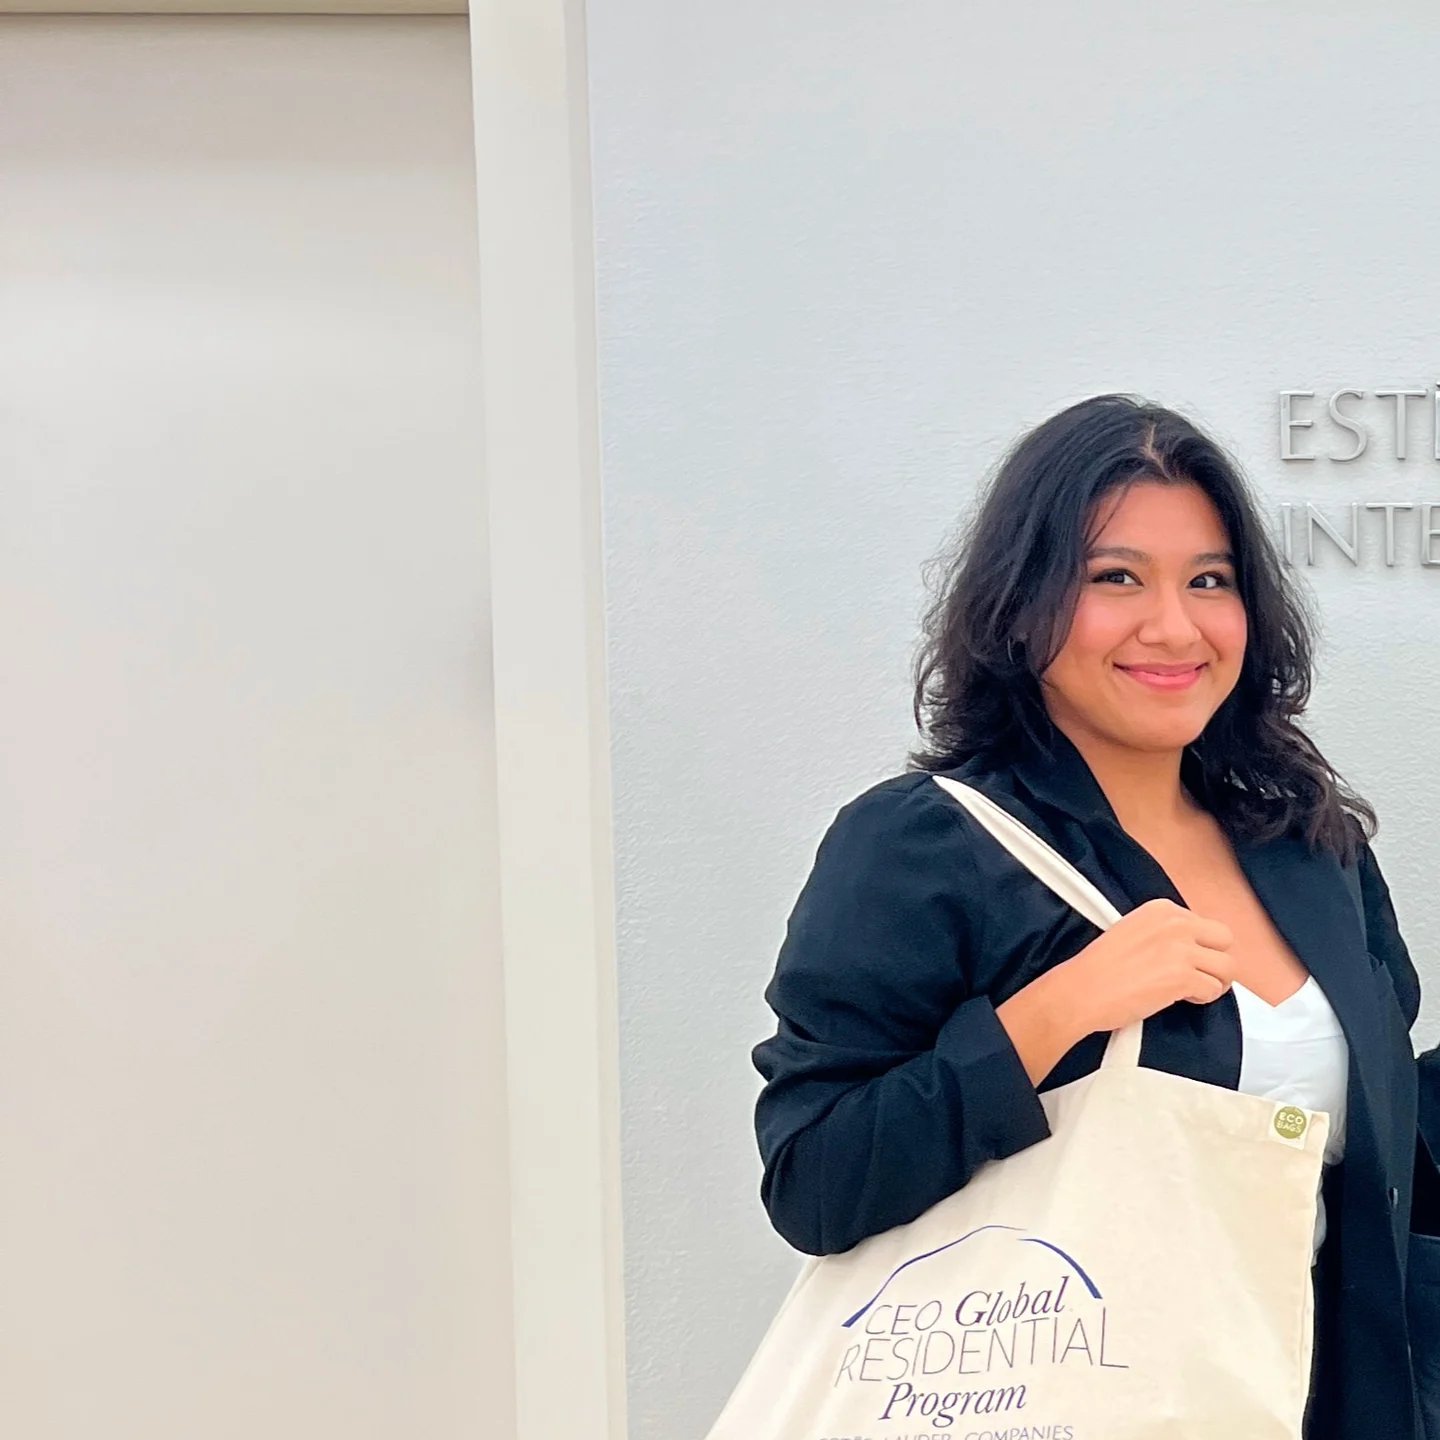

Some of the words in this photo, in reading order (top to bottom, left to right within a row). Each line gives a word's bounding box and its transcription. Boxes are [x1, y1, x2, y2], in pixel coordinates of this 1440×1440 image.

[1276, 1120, 1302, 1133] BAGS
[1278, 1111, 1304, 1125] ECO
[865, 1300, 942, 1335] CEO
[955, 1276, 1069, 1327] Global
[834, 1307, 1129, 1387] RESIDENTIAL
[878, 1382, 1027, 1428] Program
